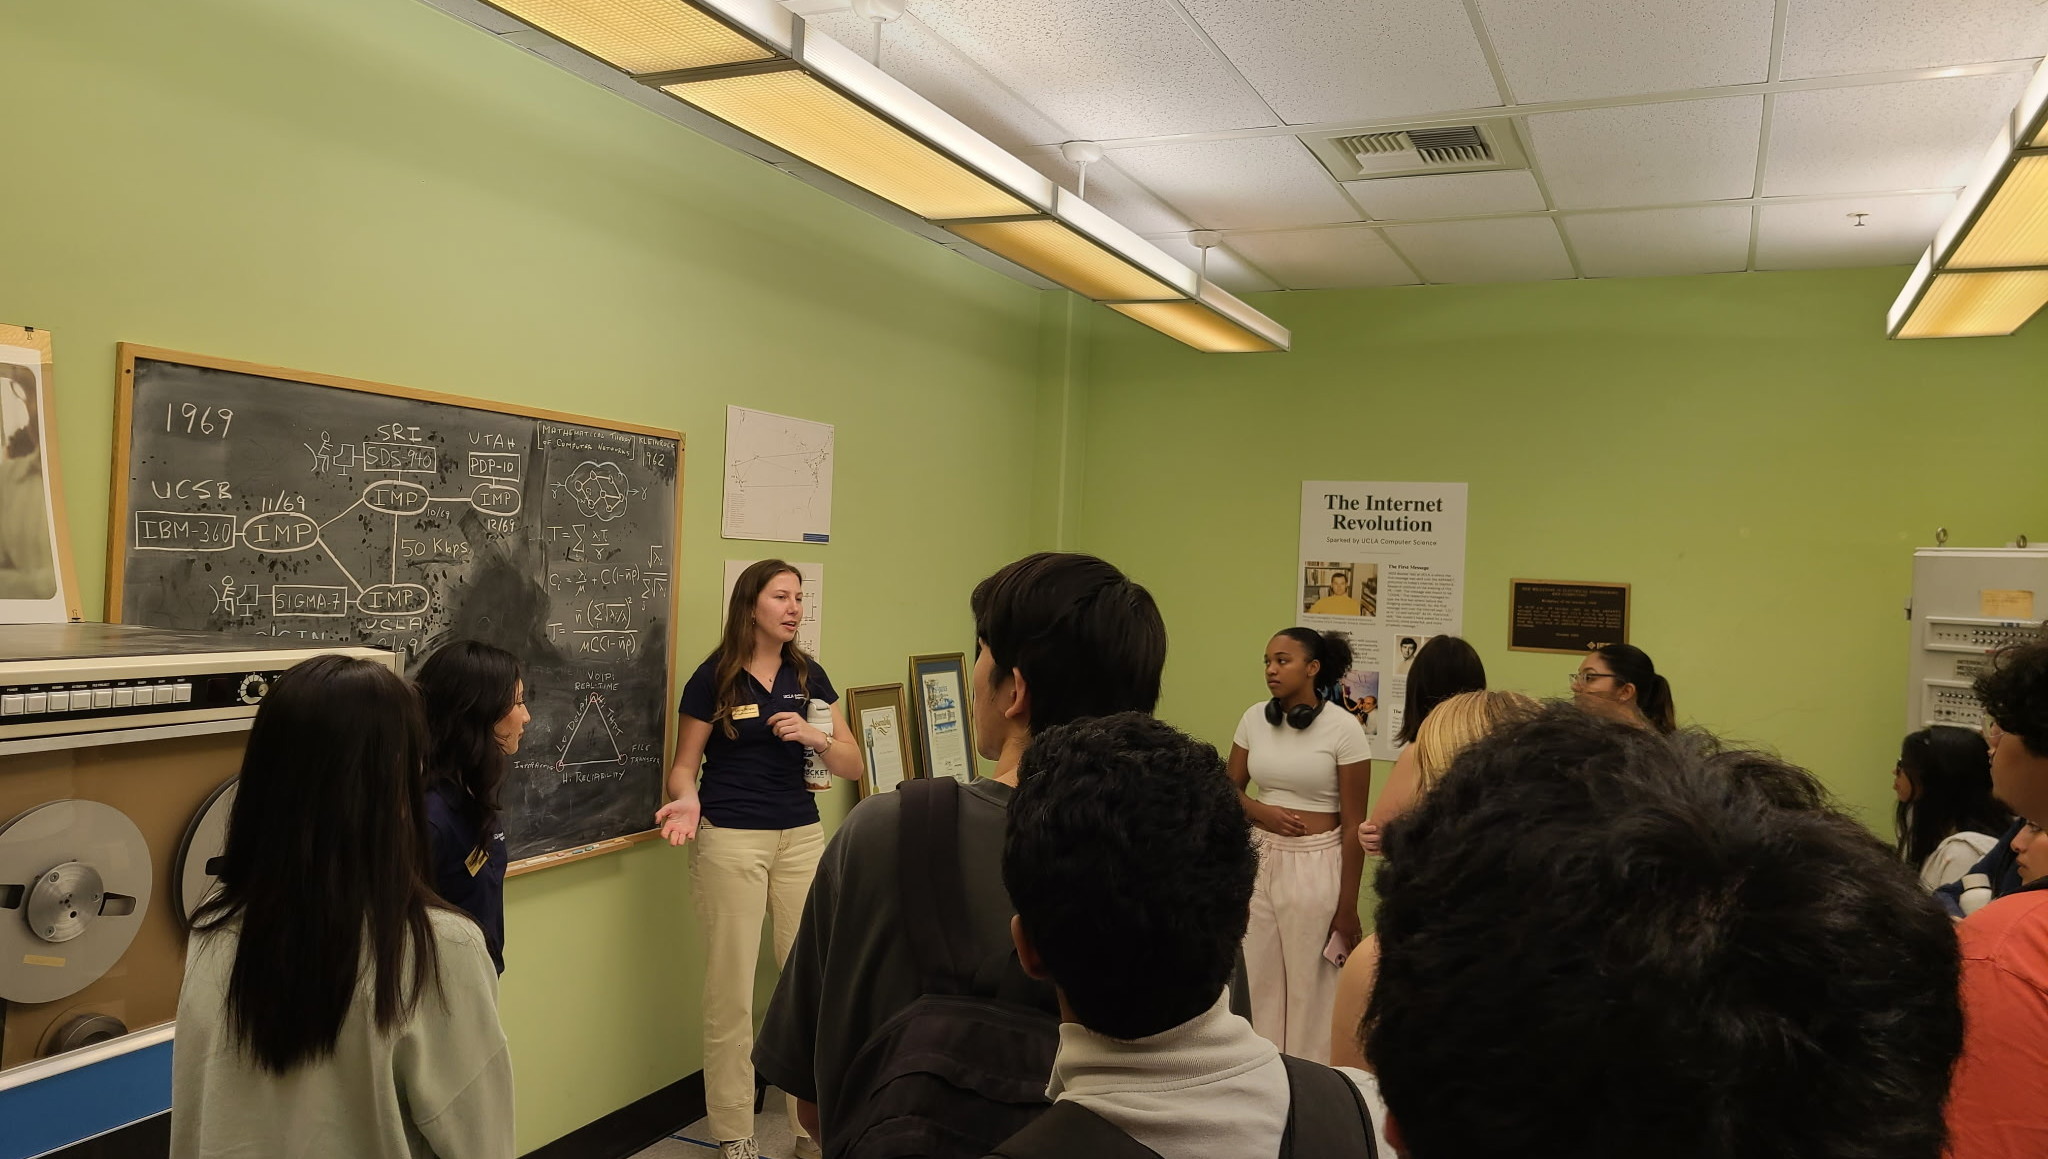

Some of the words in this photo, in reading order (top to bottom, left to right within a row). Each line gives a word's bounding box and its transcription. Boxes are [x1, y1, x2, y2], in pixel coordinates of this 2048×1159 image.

[166, 402, 234, 438] 1969
[377, 423, 422, 442] SRI
[469, 432, 516, 450] UTAH
[366, 446, 432, 468] SDS-940
[471, 457, 514, 473] PDP-10
[642, 452, 665, 467] 1962
[151, 479, 232, 500] UCSB
[374, 490, 418, 506] IMP
[261, 490, 306, 512] 11/69
[480, 492, 511, 506] IMP
[1324, 494, 1360, 510] The
[1365, 495, 1443, 512] Internet
[427, 507, 450, 519] 10/69
[139, 520, 231, 543] IBM-360
[487, 519, 515, 533] 12/69
[1332, 514, 1432, 532] Revolution
[253, 523, 313, 543] IMP
[1326, 536, 1351, 544] Sparked
[401, 538, 426, 557] 50
[433, 538, 468, 558] Kbps
[276, 593, 339, 610] SIGMA-7
[368, 590, 413, 608] IMP
[365, 617, 422, 631] UCLA
